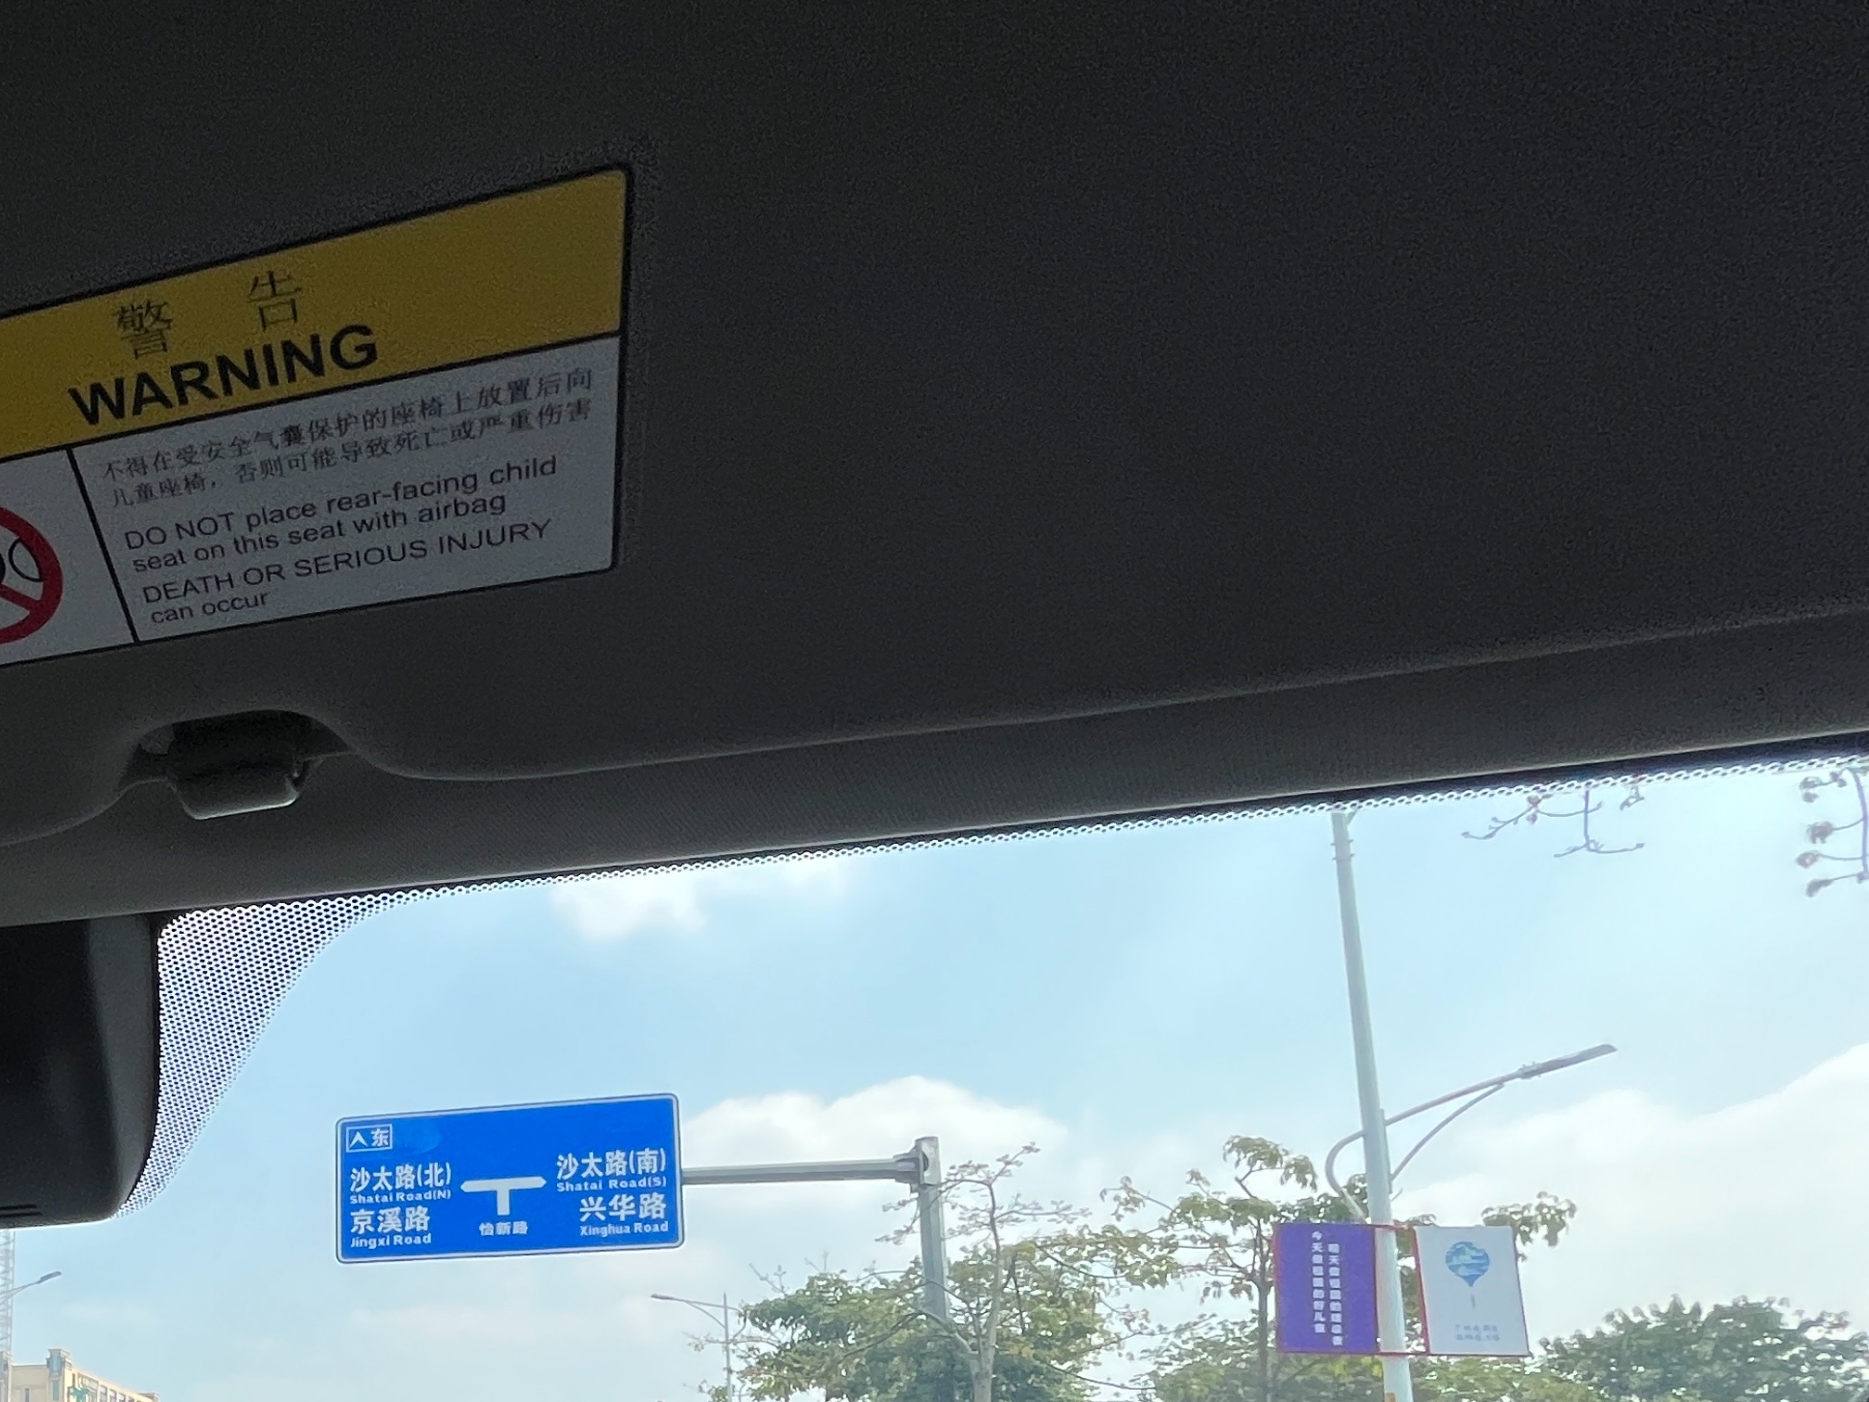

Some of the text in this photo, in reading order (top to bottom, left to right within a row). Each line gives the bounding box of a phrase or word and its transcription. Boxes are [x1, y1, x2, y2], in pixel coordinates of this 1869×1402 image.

[111, 270, 303, 360] 警告
[67, 324, 378, 426] WARNING
[124, 454, 557, 550] DO NOT place rear-facing child
[132, 494, 506, 573] seat on this seat with airbag
[142, 518, 552, 604] DEATH OR SERIOUS INJURY
[150, 592, 269, 624] can occur
[370, 1128, 389, 1147] 东
[350, 1162, 452, 1193] 沙太路(北)
[556, 1147, 667, 1180] 沙太路(南)
[350, 1189, 452, 1204] Shatai Road(N)
[556, 1176, 667, 1192] Shatai Road(S)
[350, 1205, 430, 1234] 京溪路
[579, 1192, 667, 1222] 兴华路
[350, 1233, 432, 1249] Jingxi Road
[579, 1220, 669, 1237] Xinghua Road
